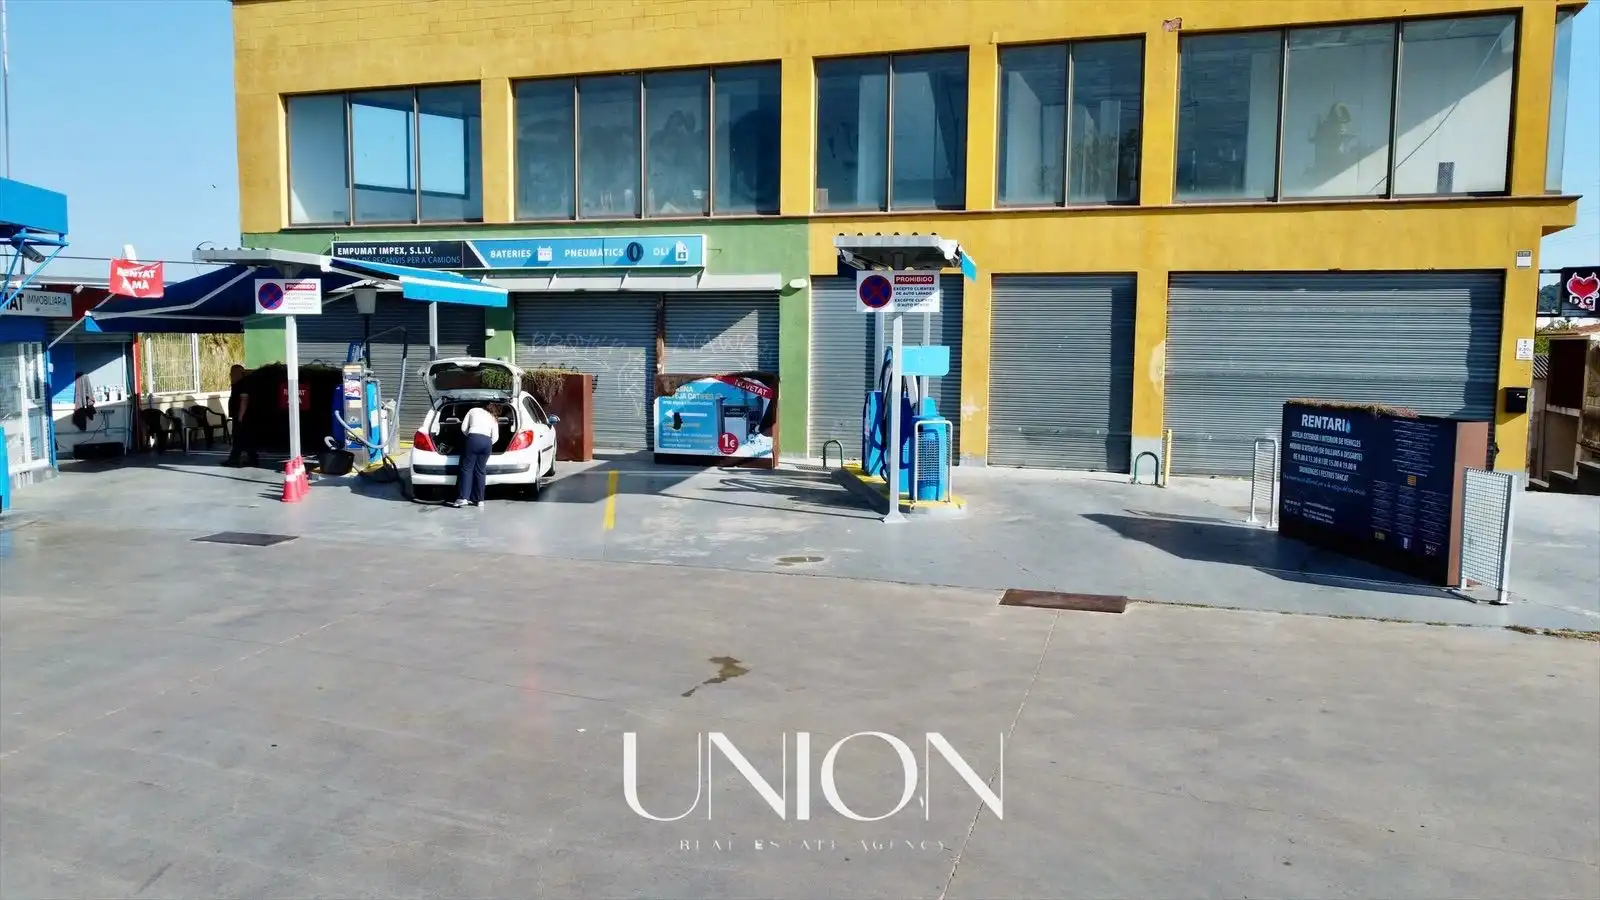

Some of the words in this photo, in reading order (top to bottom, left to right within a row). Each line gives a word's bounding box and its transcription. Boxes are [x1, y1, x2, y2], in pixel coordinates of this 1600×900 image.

[337, 247, 376, 255] EMPUMAT
[379, 246, 407, 256] IMPEX,
[409, 246, 434, 255] S.L.U.
[490, 249, 531, 258] BATERIES
[653, 247, 669, 256] OLI
[427, 255, 460, 264] CAMIONS
[1301, 413, 1346, 432] RENTARI
